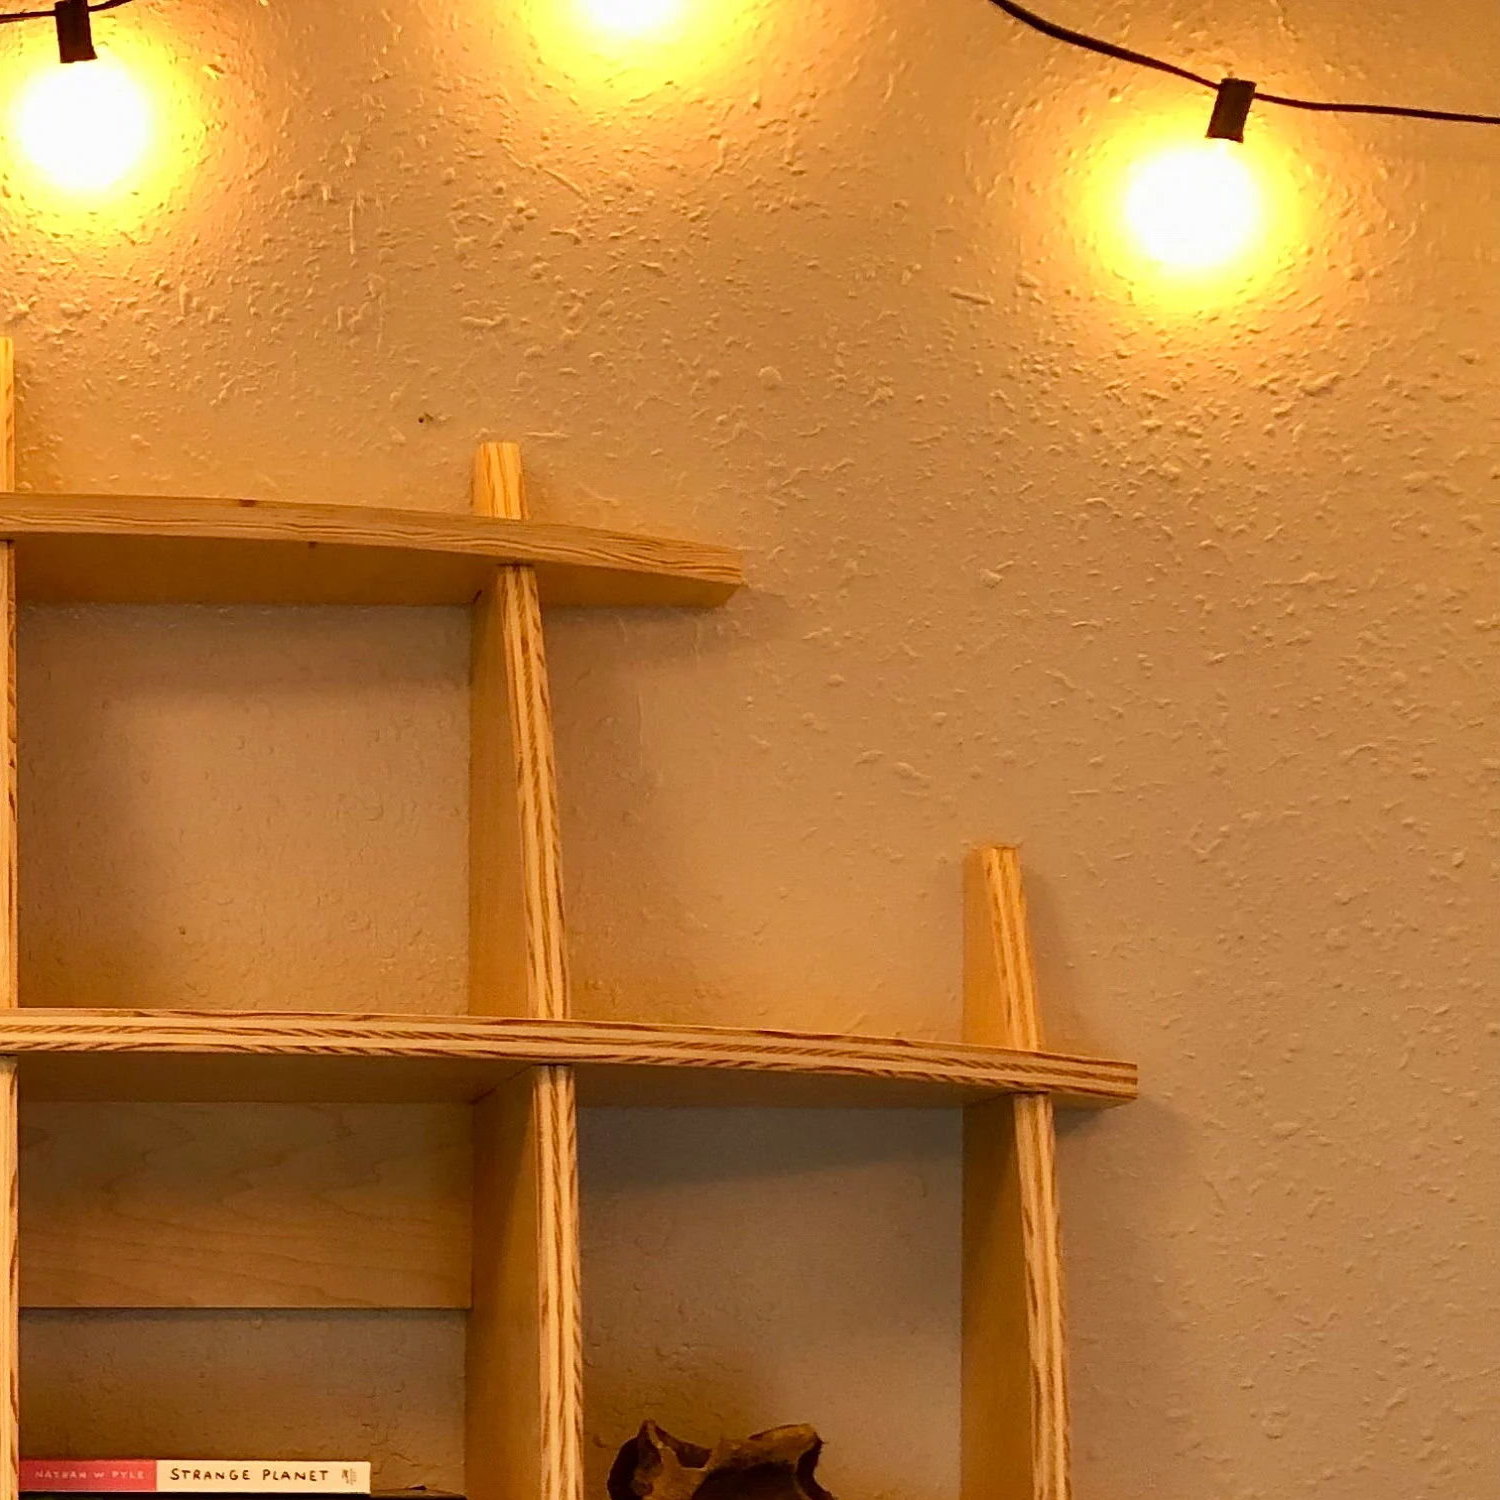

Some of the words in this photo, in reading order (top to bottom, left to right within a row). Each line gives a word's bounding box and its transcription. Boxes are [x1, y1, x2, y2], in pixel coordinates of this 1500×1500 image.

[35, 1470, 87, 1480] NATHAN
[111, 1470, 145, 1480] PYLE
[169, 1468, 251, 1481] STRANGE
[262, 1468, 329, 1481] PLANET
